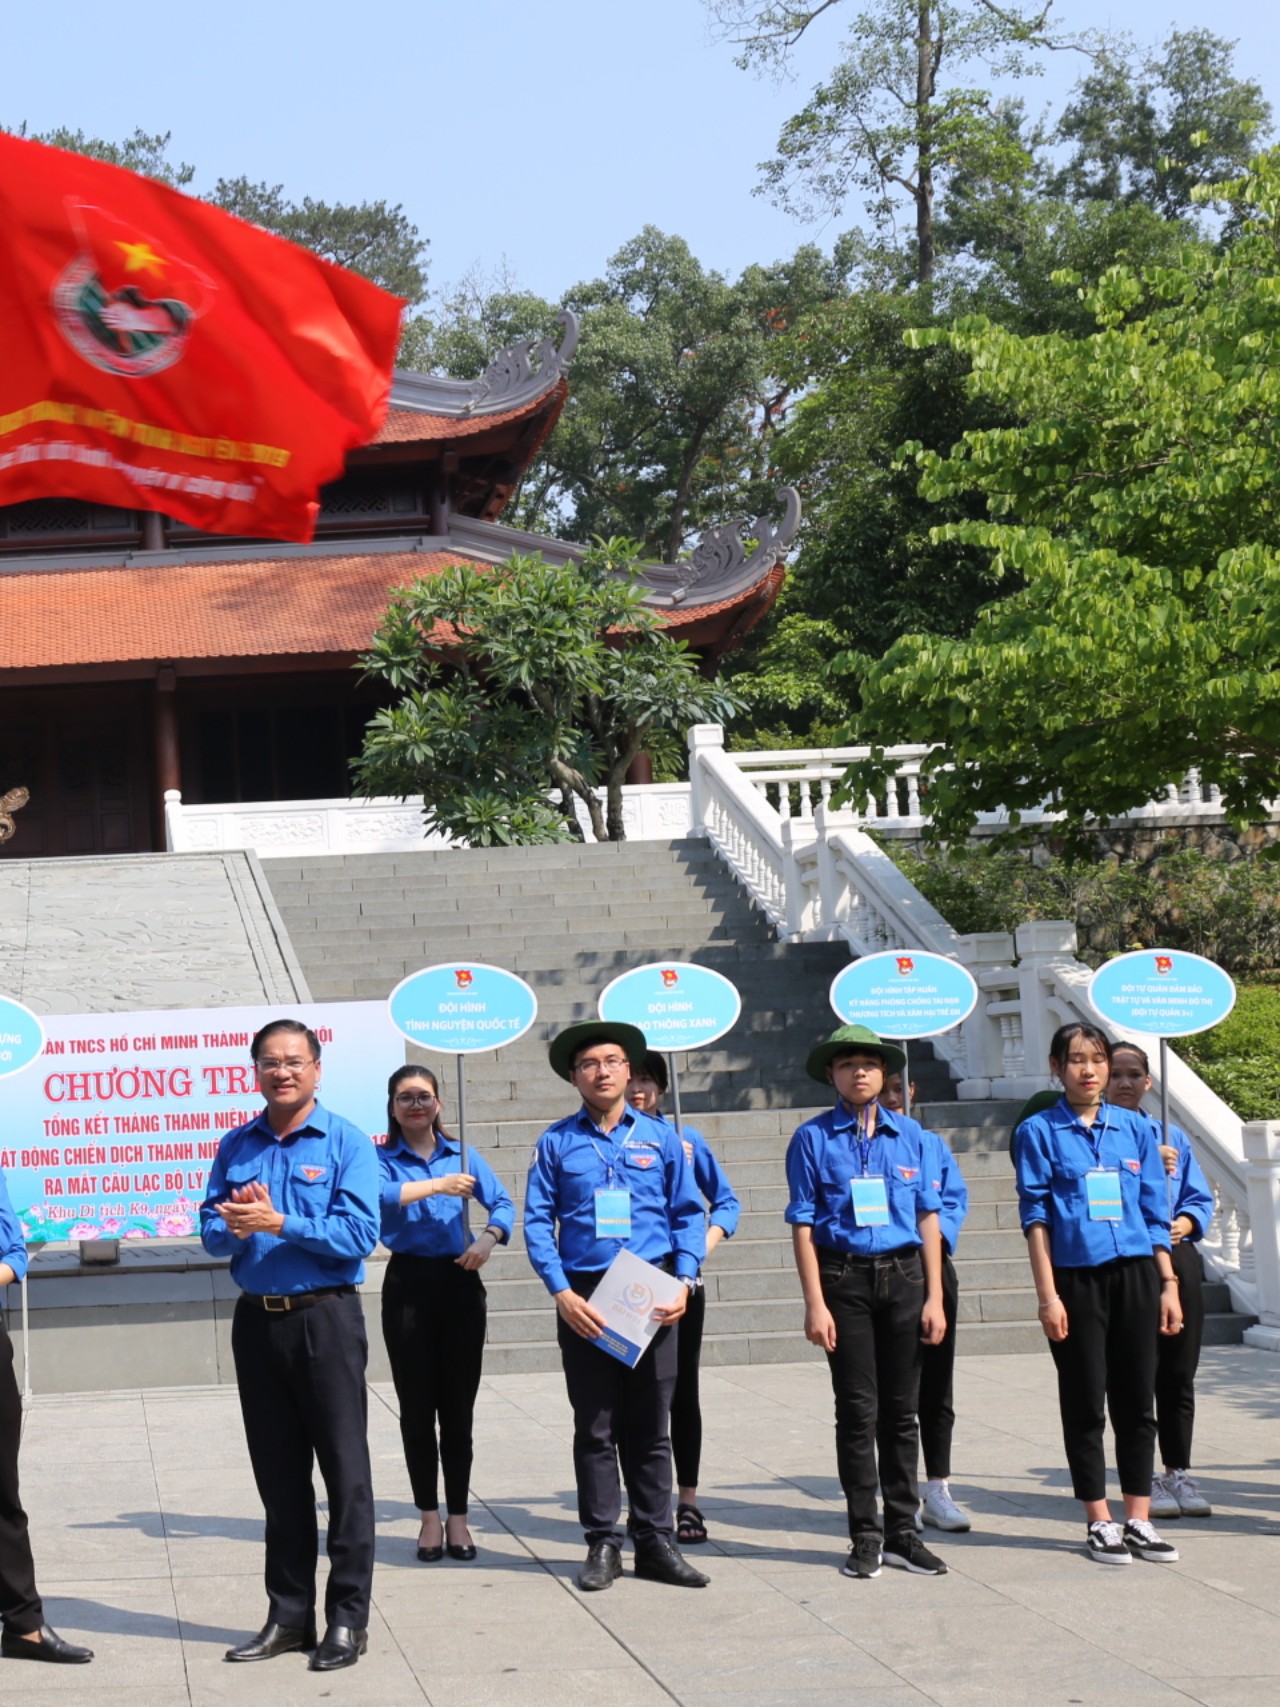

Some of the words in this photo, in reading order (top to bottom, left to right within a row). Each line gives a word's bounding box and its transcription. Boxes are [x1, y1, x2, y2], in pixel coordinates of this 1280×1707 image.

[438, 1003, 458, 1015] ĐỘI
[460, 1001, 486, 1013] HÌNH
[648, 1003, 666, 1014] ĐỘI
[668, 1001, 693, 1012] HÌNH
[405, 1019, 430, 1031] TÌNH
[432, 1018, 475, 1033] NGUYỆN
[476, 1016, 507, 1031] QUỐC
[508, 1016, 521, 1029] TẾ
[653, 1018, 687, 1030] THÔNG
[689, 1018, 716, 1028] XANH
[68, 1038, 106, 1054] TNCS
[110, 1033, 128, 1052] HỒ
[133, 1034, 156, 1051] CHÍ
[161, 1034, 198, 1050] MINH
[202, 1031, 249, 1048] THÀNH
[43, 1066, 194, 1103] CHƯƠNG
[43, 1111, 80, 1137] TỔNG
[84, 1110, 109, 1135] KẾT
[114, 1112, 160, 1134] THÁNG
[164, 1113, 210, 1132] THANH
[214, 1107, 248, 1129] NIÊN
[21, 1145, 59, 1171] ĐỘNG
[64, 1140, 106, 1166] CHIẾN
[110, 1145, 143, 1168] DỊCH
[147, 1143, 193, 1162] THANH
[197, 1138, 221, 1160] NIÊ
[44, 1178, 63, 1196] RA
[67, 1171, 98, 1195] MẮT
[102, 1172, 129, 1193] CÂU
[134, 1174, 160, 1196] LẠC
[164, 1169, 183, 1194] BỘ
[187, 1167, 204, 1189] LÝ
[48, 1205, 75, 1219] Khu
[80, 1205, 95, 1218] Di
[100, 1203, 125, 1217] tích
[155, 1202, 189, 1216] ngày
